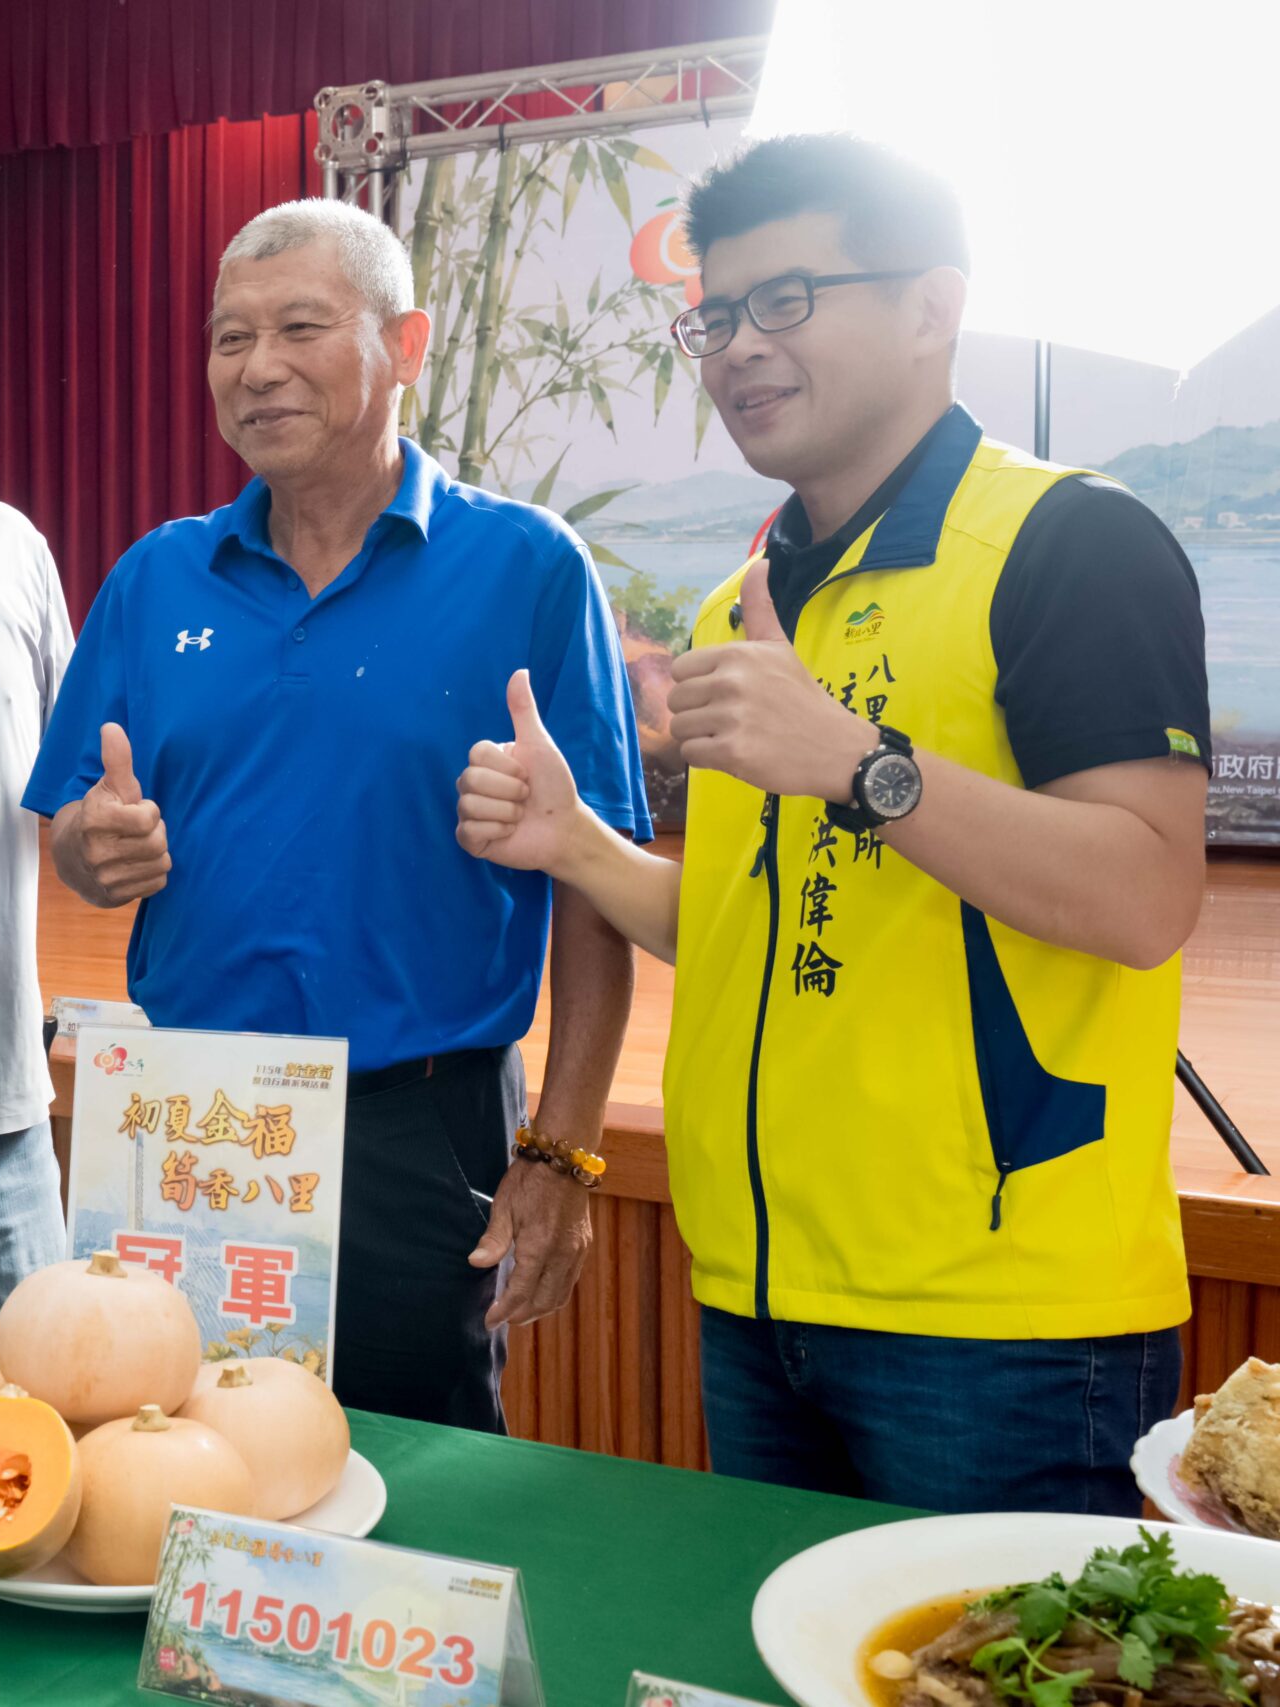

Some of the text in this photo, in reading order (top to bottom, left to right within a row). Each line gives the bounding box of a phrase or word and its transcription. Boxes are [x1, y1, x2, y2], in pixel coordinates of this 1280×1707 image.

[118, 1089, 297, 1159] 初夏金福
[161, 1150, 321, 1213] 筍香八里
[181, 1581, 476, 1686] 11501023
